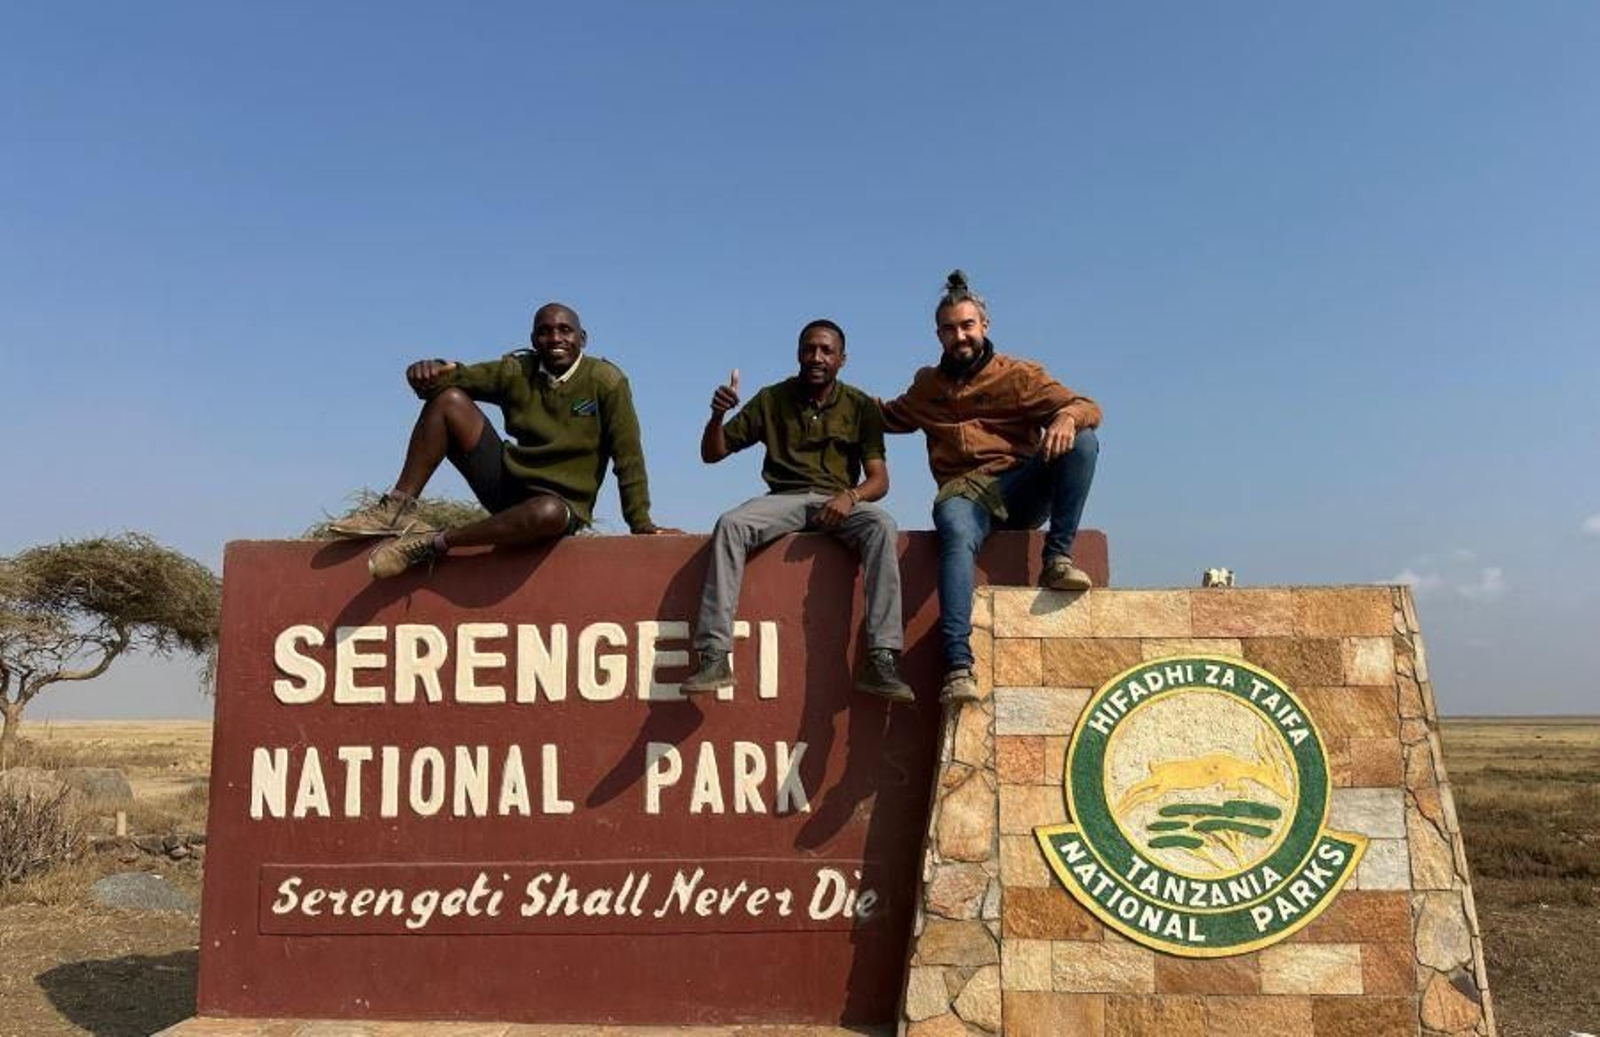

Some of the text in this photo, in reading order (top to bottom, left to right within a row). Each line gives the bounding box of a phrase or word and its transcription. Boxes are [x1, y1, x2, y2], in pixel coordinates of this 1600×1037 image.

[1088, 664, 1309, 746] HIFADHI ZA TAIFA
[249, 740, 812, 820] NATIONAL PARK
[271, 866, 878, 929] Serengeti Shall Never Die
[1060, 840, 1345, 942] NATIONAL PARKS
[1123, 855, 1282, 908] TANZANIA
